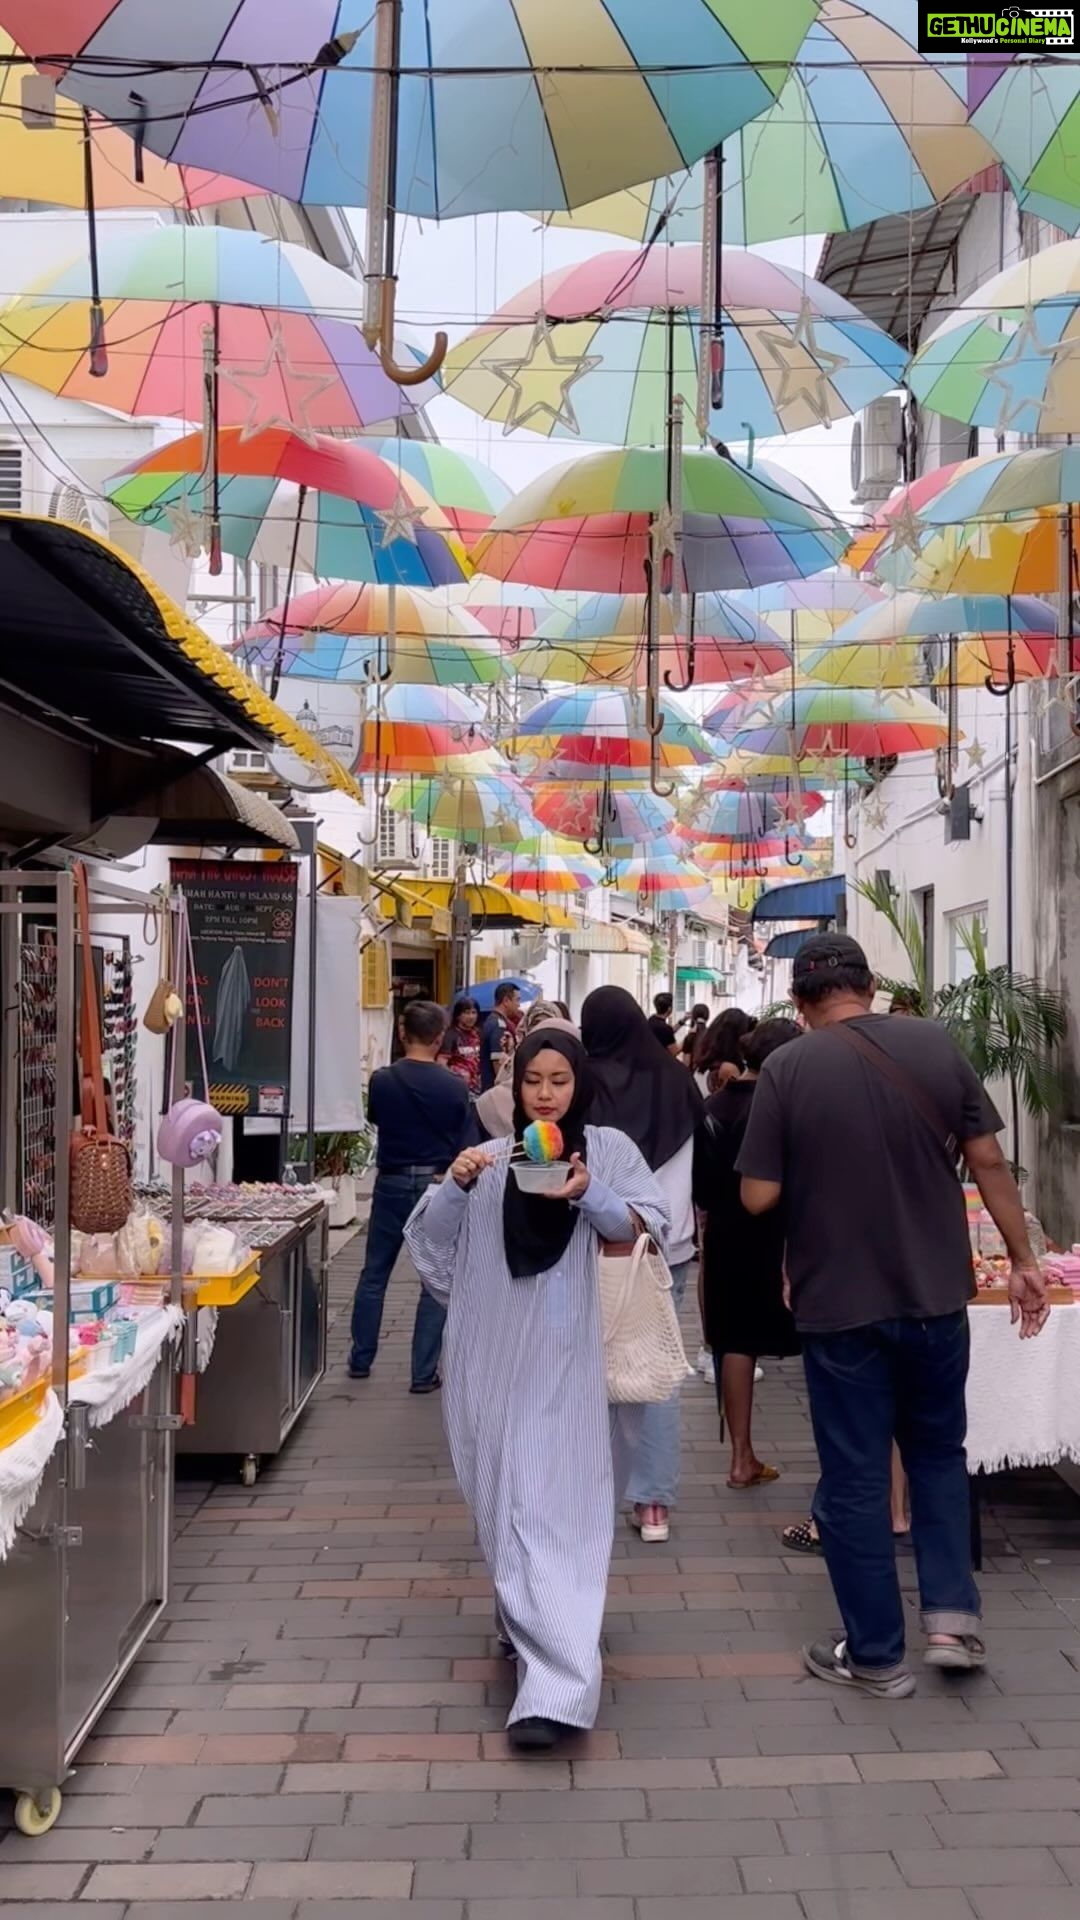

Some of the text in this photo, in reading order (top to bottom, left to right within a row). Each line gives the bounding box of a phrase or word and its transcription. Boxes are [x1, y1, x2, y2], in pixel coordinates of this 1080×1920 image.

[248, 891, 280, 901] ISLAND
[254, 977, 288, 988] DON'T
[256, 997, 286, 1008] LOOK
[256, 1017, 285, 1028] BACK
